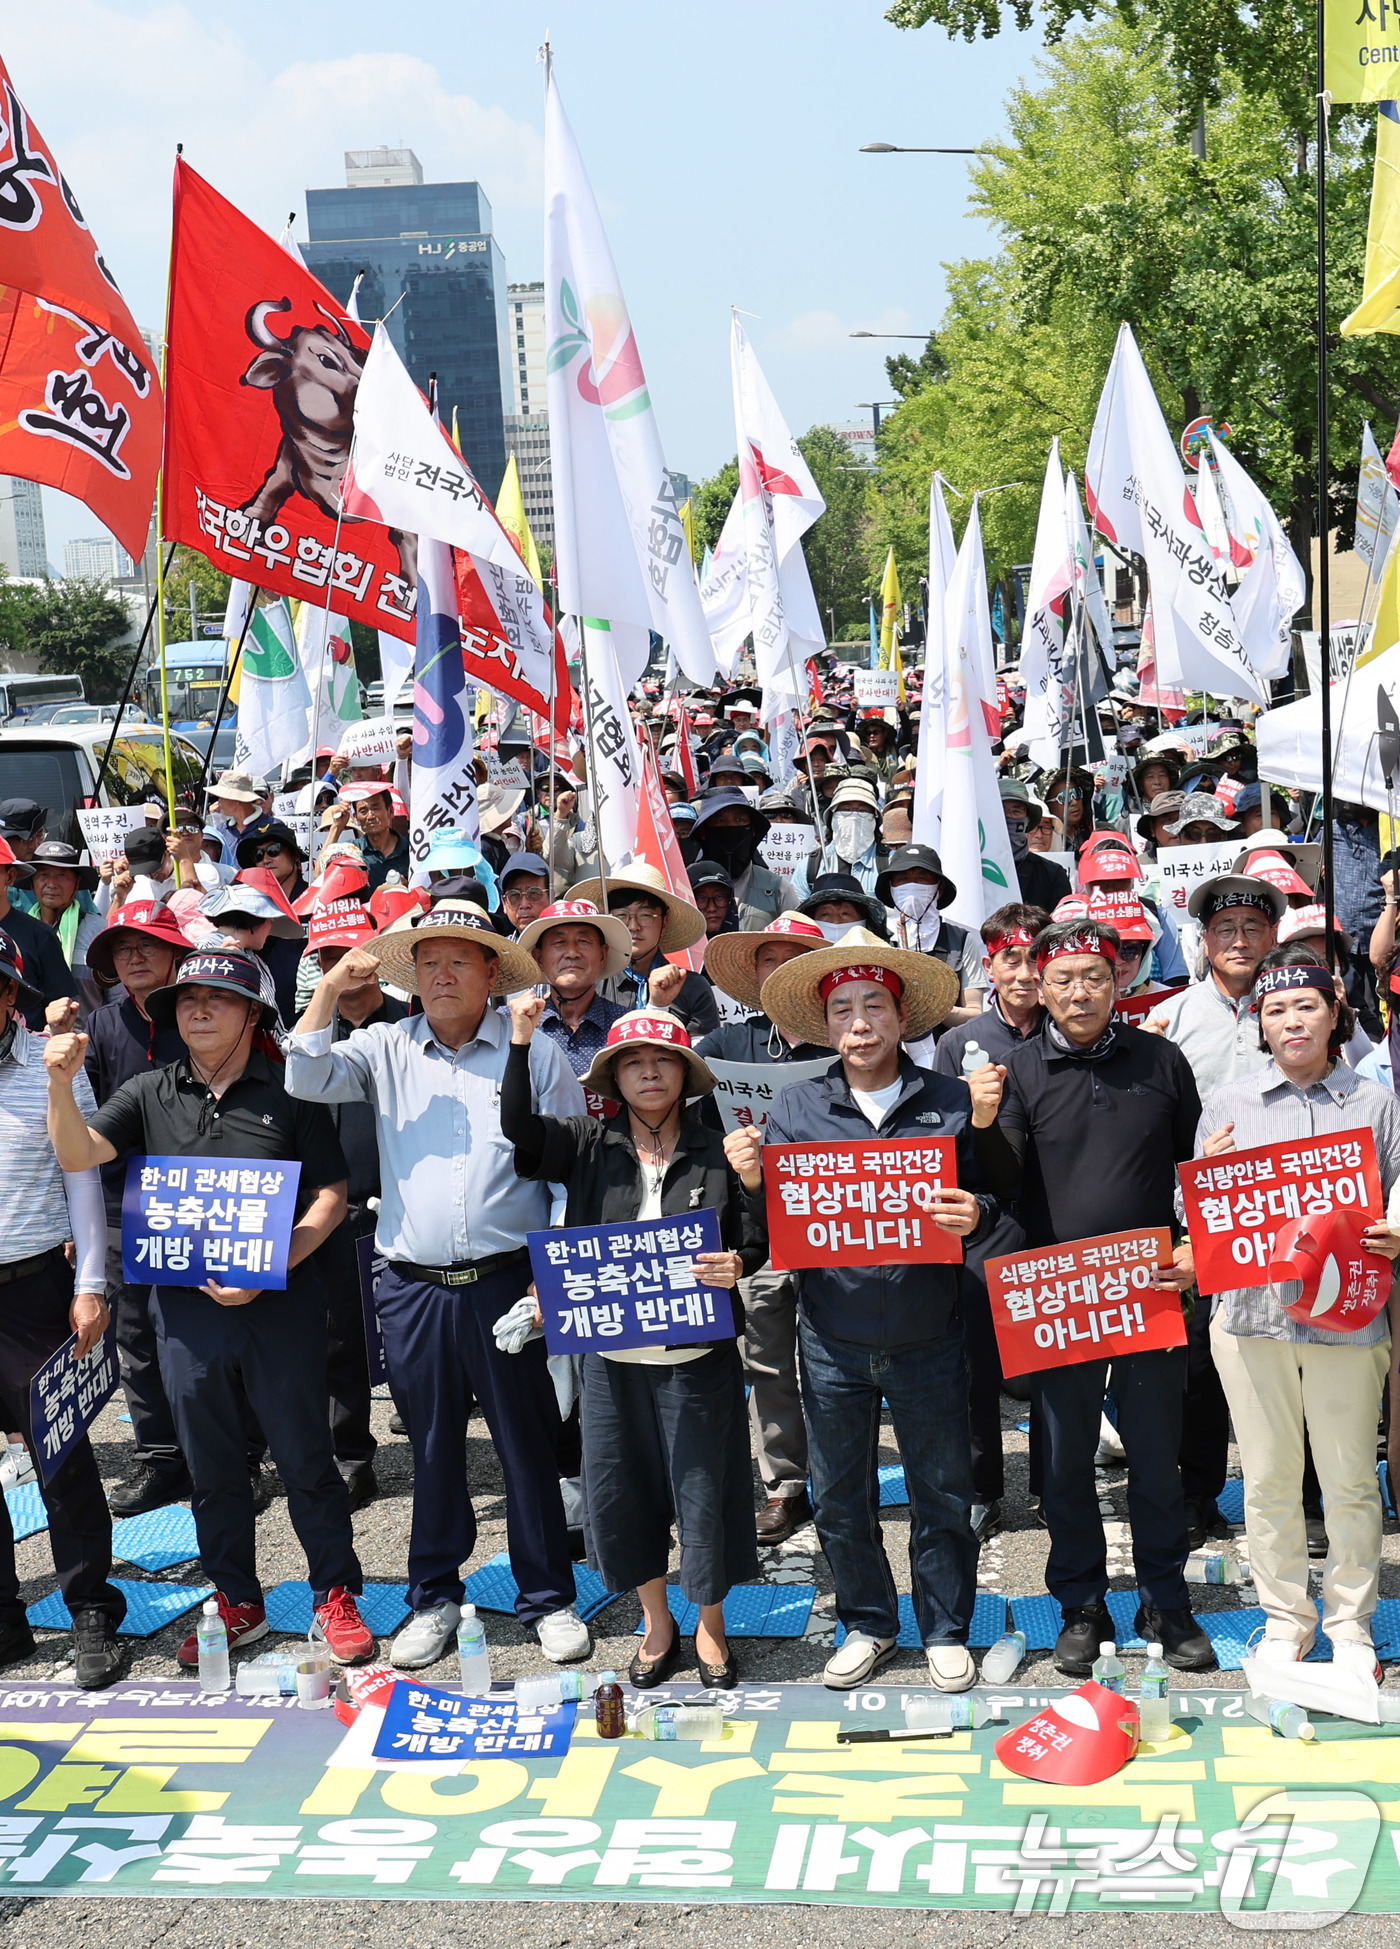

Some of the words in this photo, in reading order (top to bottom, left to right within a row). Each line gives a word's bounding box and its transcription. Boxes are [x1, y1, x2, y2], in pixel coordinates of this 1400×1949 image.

[418, 243, 441, 254] HJ
[458, 241, 487, 253] 중공업
[383, 463, 410, 482] 법인
[387, 451, 415, 467] 사단
[173, 668, 205, 682] 752
[360, 729, 376, 740] 사과
[378, 725, 394, 737] 수입
[767, 851, 792, 861] 안전을
[1163, 862, 1206, 879] 미국산
[312, 897, 362, 920] 소키워서
[1090, 885, 1139, 908] 소키워서
[1088, 908, 1116, 921] 남는건
[619, 1025, 633, 1040] 투
[655, 1022, 674, 1040] 쟁
[718, 1079, 773, 1100] 미국산
[776, 1153, 857, 1177] 식량안보
[862, 1148, 943, 1175] 국민건강
[1194, 1158, 1276, 1192] 식량안보
[1280, 1141, 1362, 1176] 국민건강
[140, 1166, 189, 1192] 한·미
[194, 1168, 285, 1195] 관세협상
[779, 1178, 942, 1216] 협상대상이
[1199, 1172, 1369, 1234] 협상대상이
[145, 1196, 268, 1234] 농축산물
[545, 1237, 602, 1266] 한·미
[608, 1223, 703, 1259] 관세협상
[806, 1218, 922, 1252] 아니다!
[1231, 1231, 1276, 1268] 아
[135, 1235, 194, 1271] 개방
[203, 1238, 274, 1273] 반대!
[999, 1253, 1077, 1286] 식량안보
[1081, 1237, 1159, 1269] 국민건강
[562, 1254, 698, 1302] 농축산물
[1003, 1262, 1162, 1322] 협상대상이
[1340, 1259, 1363, 1316] 생존권
[1361, 1269, 1380, 1307] 쟁취
[558, 1302, 625, 1338] 개방
[635, 1292, 716, 1333] 반대!
[1033, 1302, 1147, 1350] 아니다!
[43, 1404, 75, 1460] 개방
[77, 1357, 114, 1420] 반대!
[408, 1690, 461, 1715] 한·미
[411, 1711, 548, 1735] 농축산물
[1028, 1716, 1075, 1753] 생존권
[391, 1732, 464, 1754] 개방
[473, 1734, 555, 1753] 반대!
[1013, 1733, 1049, 1763] 쟁취
[449, 1817, 738, 1888] 협상
